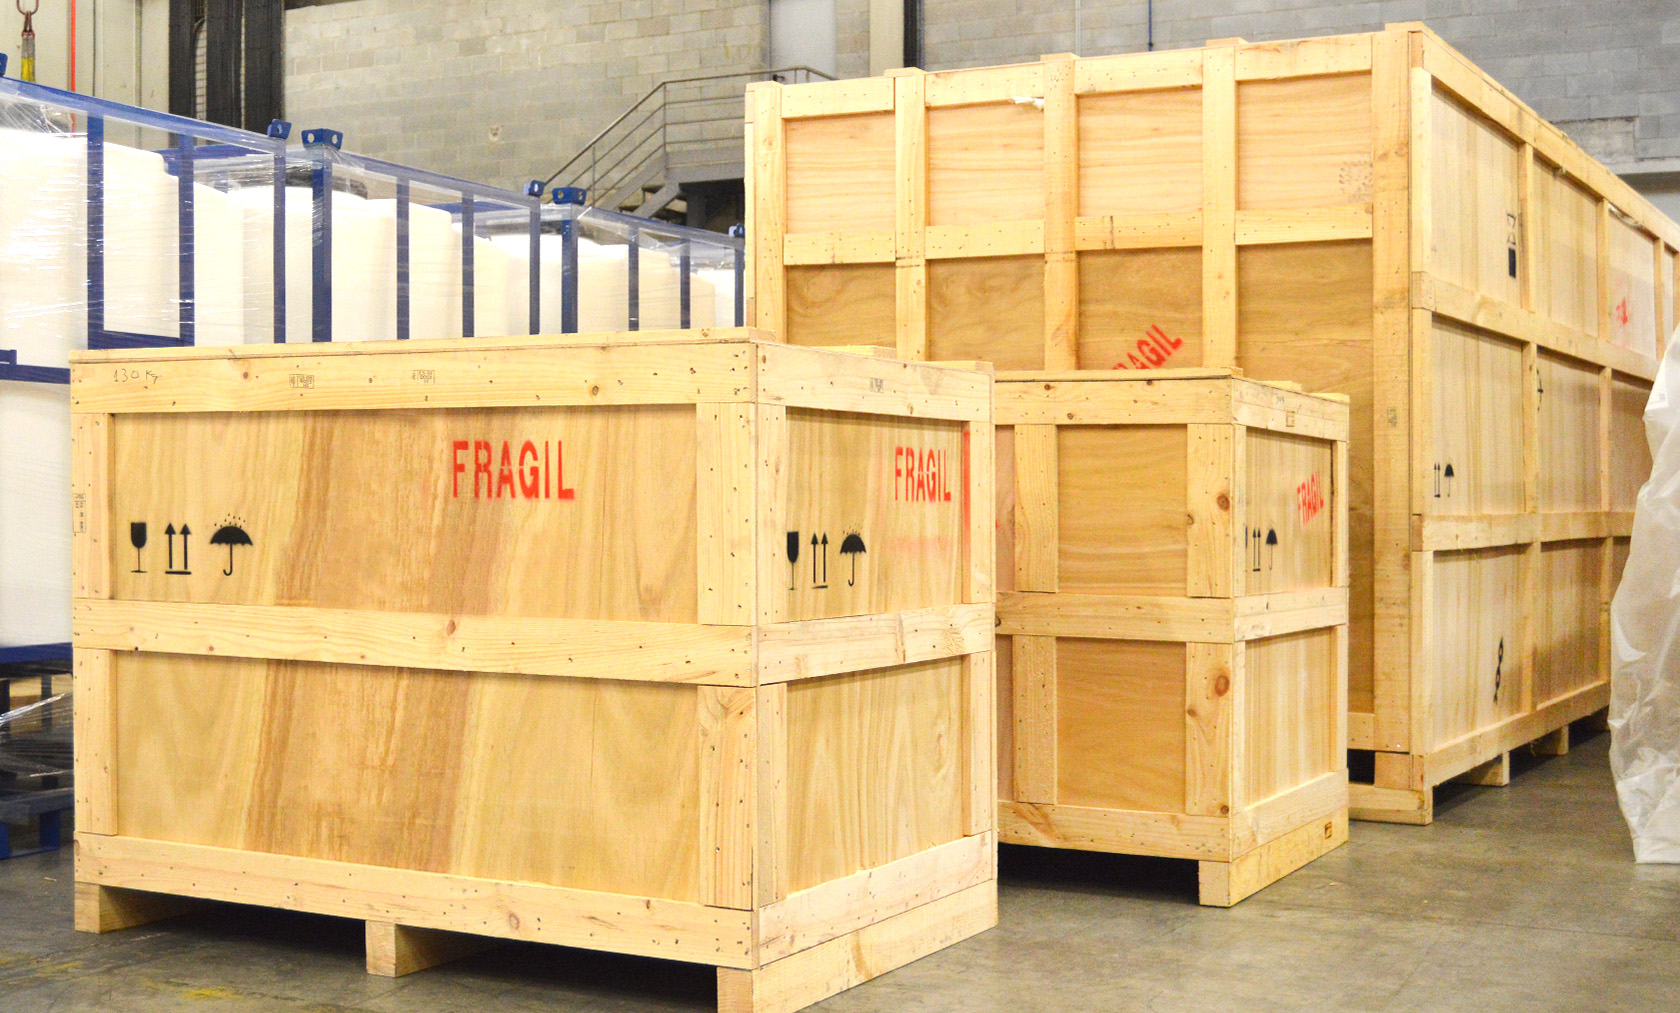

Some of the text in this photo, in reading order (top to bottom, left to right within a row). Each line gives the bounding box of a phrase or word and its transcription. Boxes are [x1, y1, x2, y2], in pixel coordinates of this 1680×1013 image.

[113, 368, 140, 383] 130
[452, 439, 575, 500] FRAGIL
[894, 445, 952, 503] FRAGIL
[1296, 469, 1325, 528] FRAGIL
